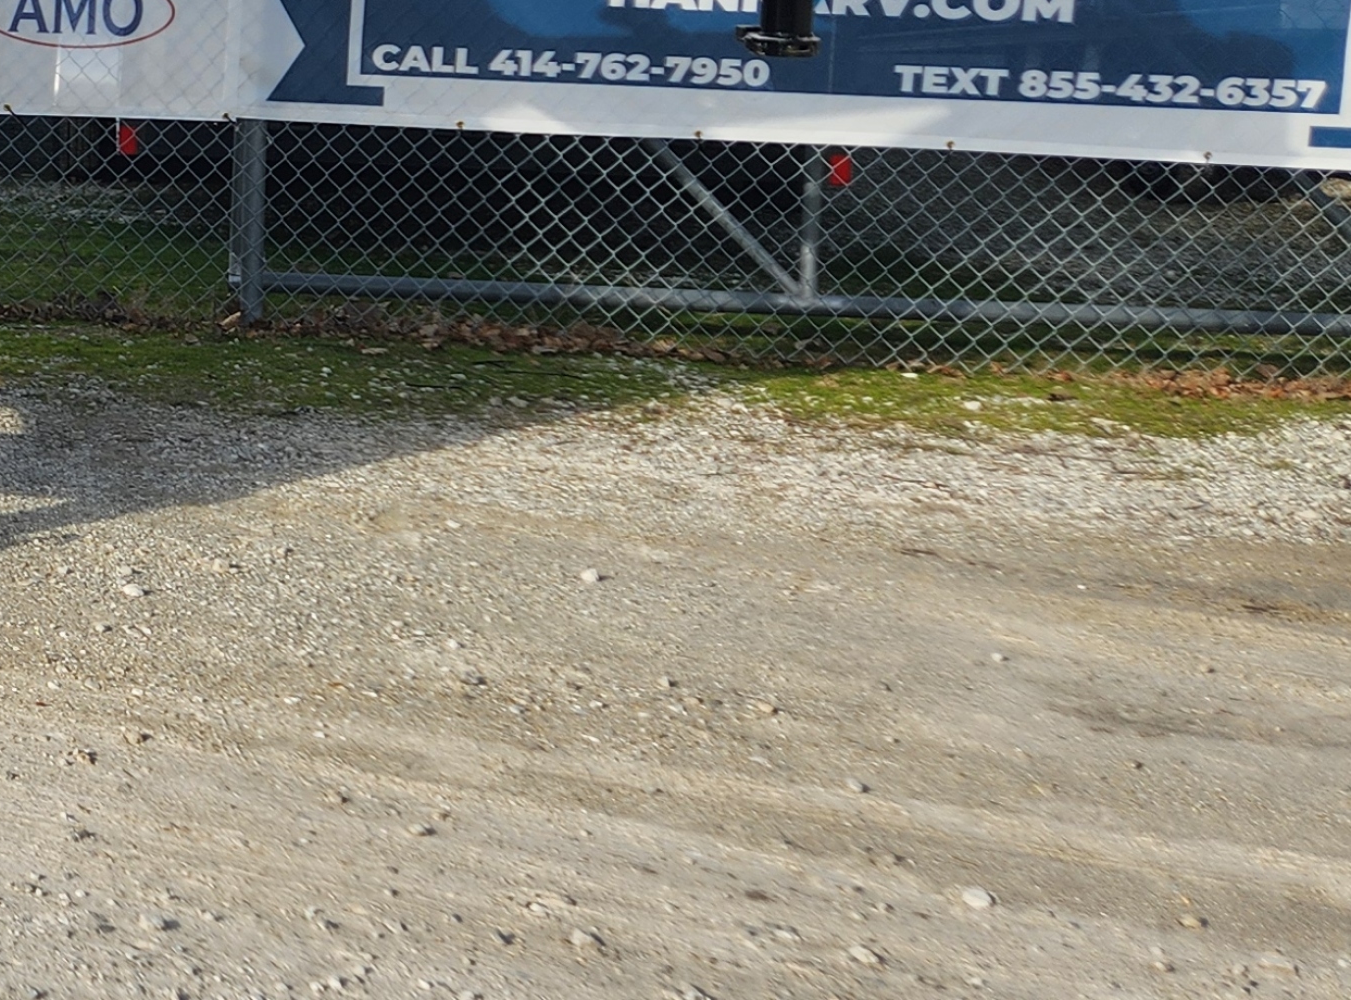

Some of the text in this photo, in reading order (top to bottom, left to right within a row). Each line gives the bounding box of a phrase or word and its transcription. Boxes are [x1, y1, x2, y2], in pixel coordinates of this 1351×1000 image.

[372, 44, 770, 88] CALL 414-762-7950
[893, 65, 1328, 110] TEXT 855-432-6357
